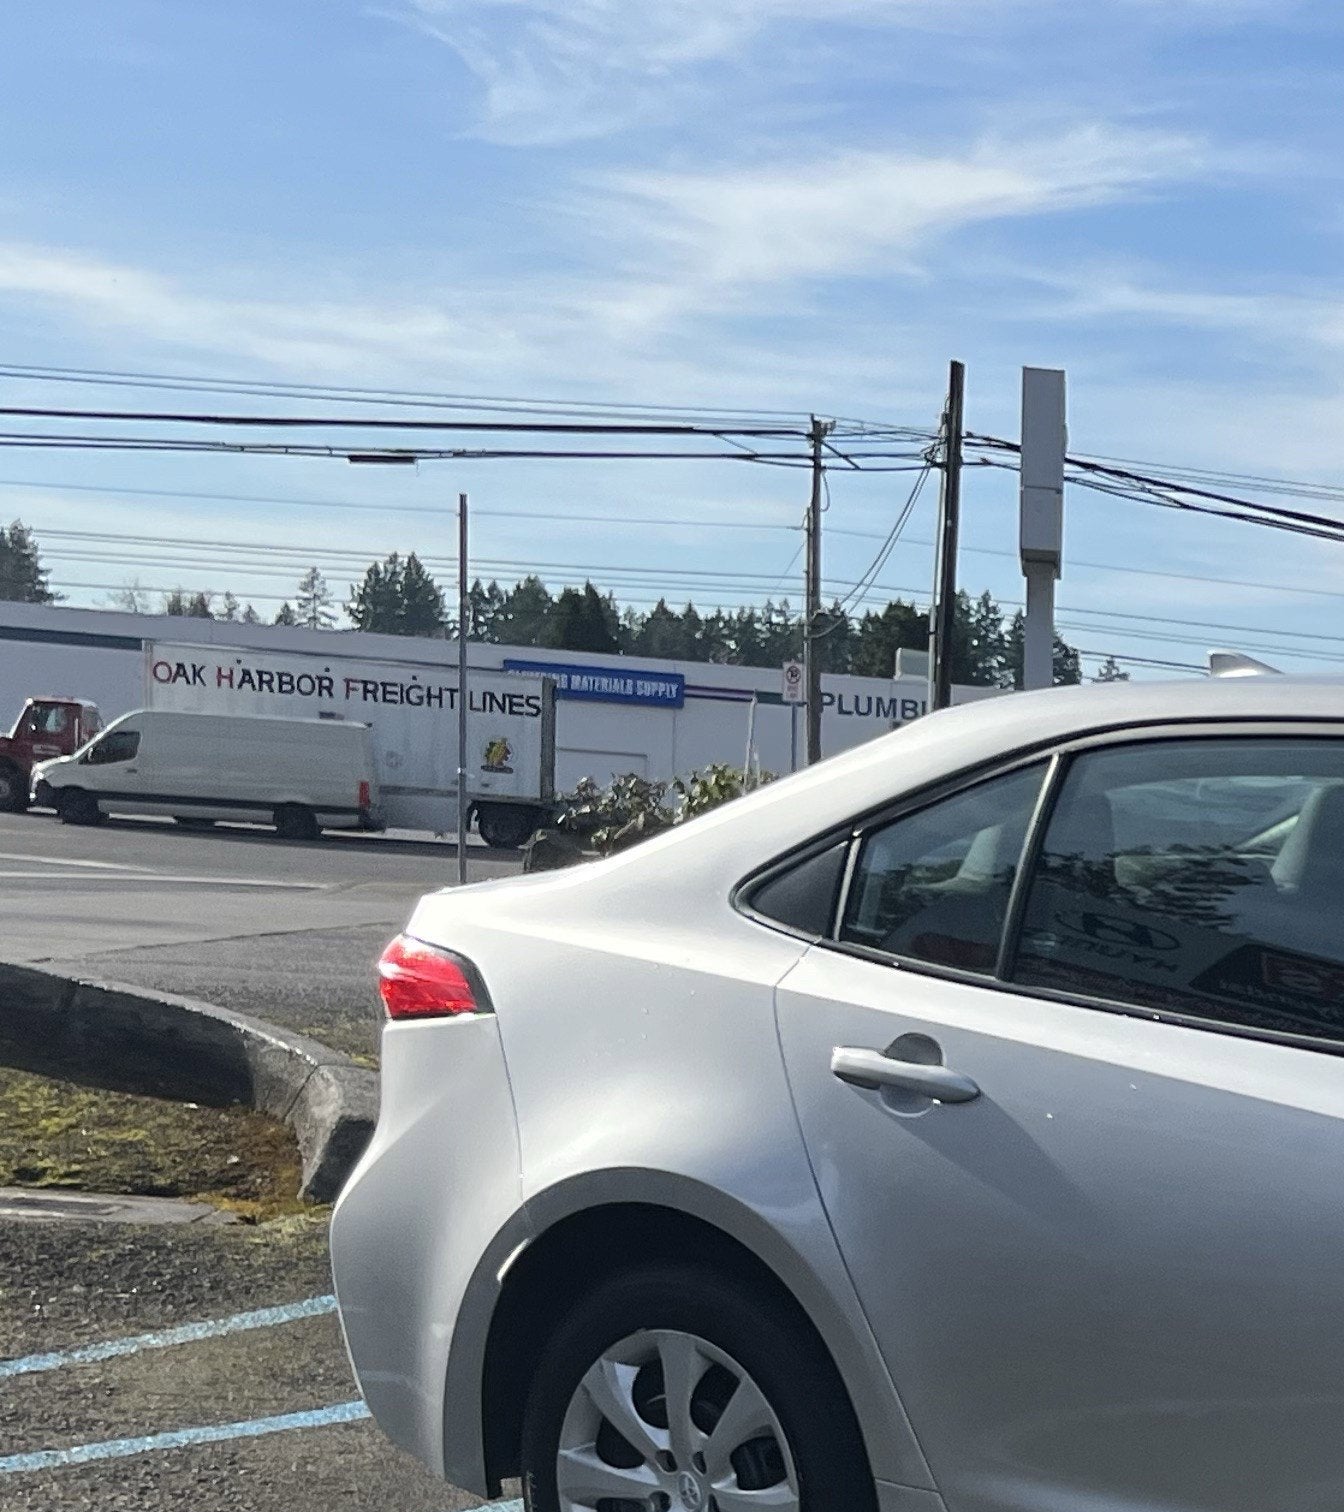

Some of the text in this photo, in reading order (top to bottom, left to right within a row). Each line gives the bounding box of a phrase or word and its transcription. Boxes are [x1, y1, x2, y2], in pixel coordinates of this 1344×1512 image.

[153, 661, 542, 718] OAK HARBOR FREIGHT LINES
[571, 674, 633, 695] MATERIALS
[636, 680, 679, 699] SUPPLY
[820, 692, 928, 719] PLUMBI
